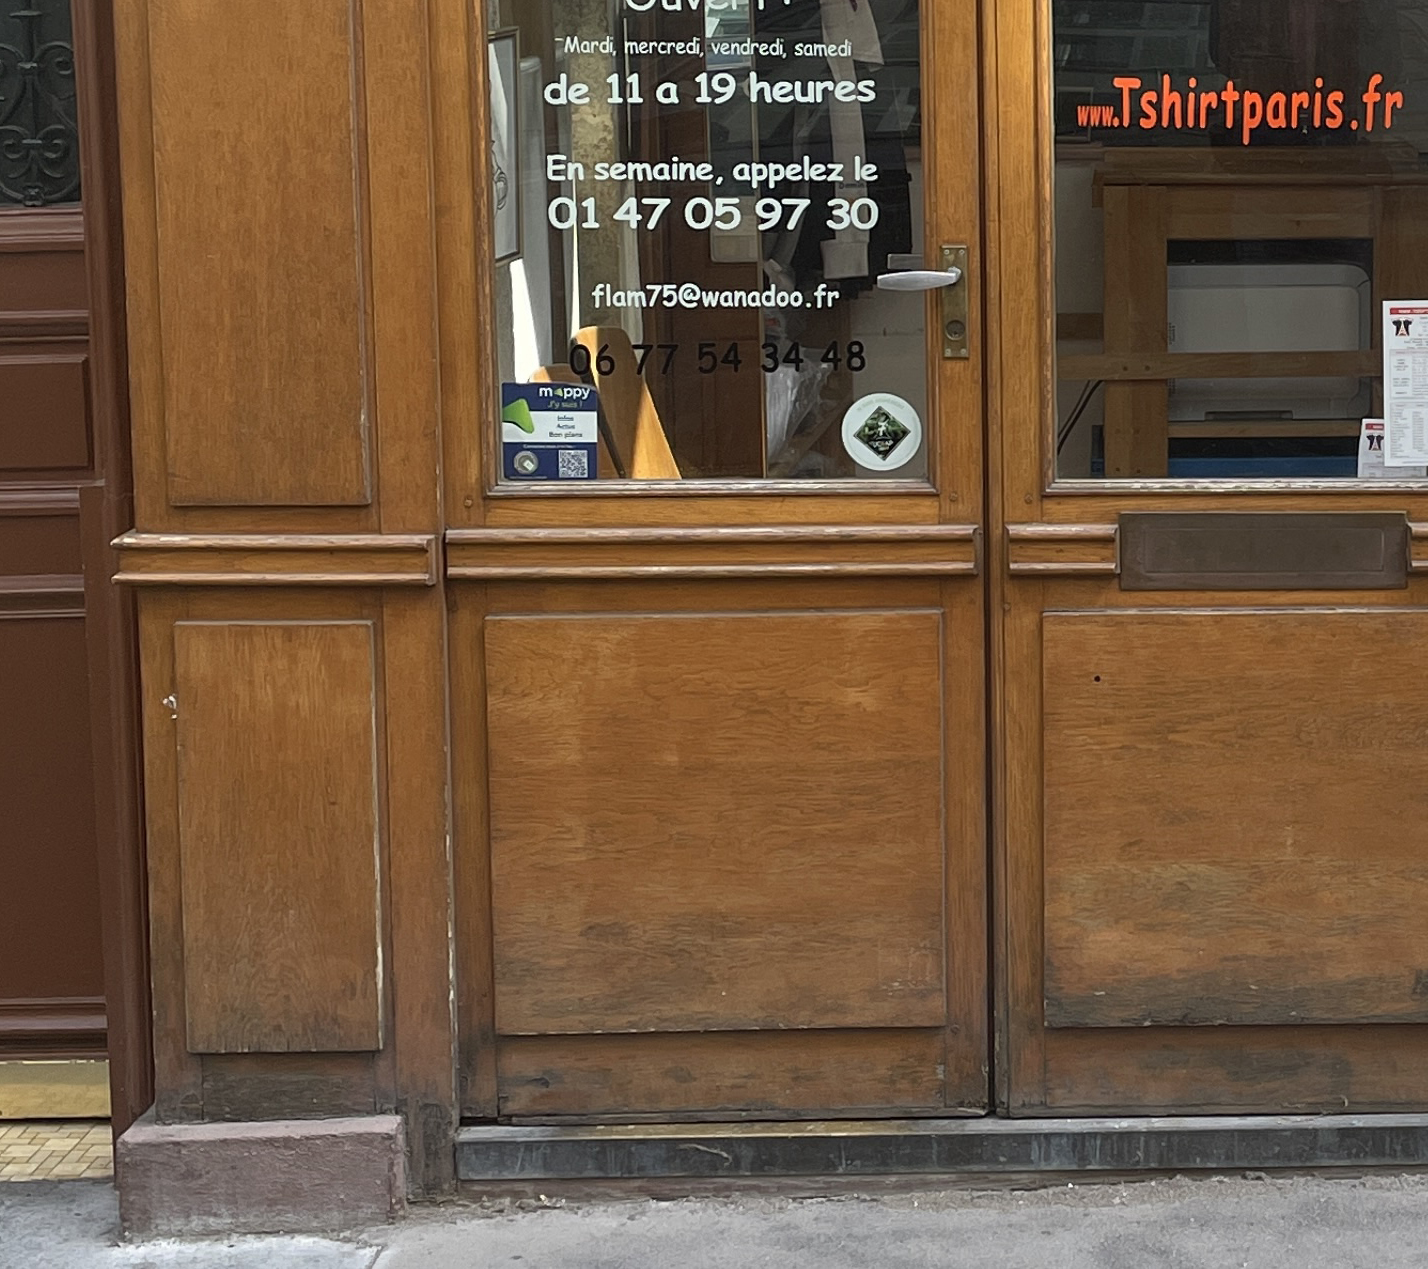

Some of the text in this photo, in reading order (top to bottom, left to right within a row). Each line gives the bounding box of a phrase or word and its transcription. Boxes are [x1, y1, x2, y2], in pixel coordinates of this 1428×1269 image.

[564, 36, 852, 59] Mardi, mercredi, vendredi, samedi
[543, 71, 876, 105] de 11 a 19 heures
[1077, 73, 1404, 145] www.Tshirtparis.fr
[546, 155, 879, 189] En semaine, appelez le
[548, 196, 879, 231] 01 47 05 97 30
[592, 283, 840, 309] flam75@wanadoo.fr
[570, 340, 866, 376] 06 77 54 34 48
